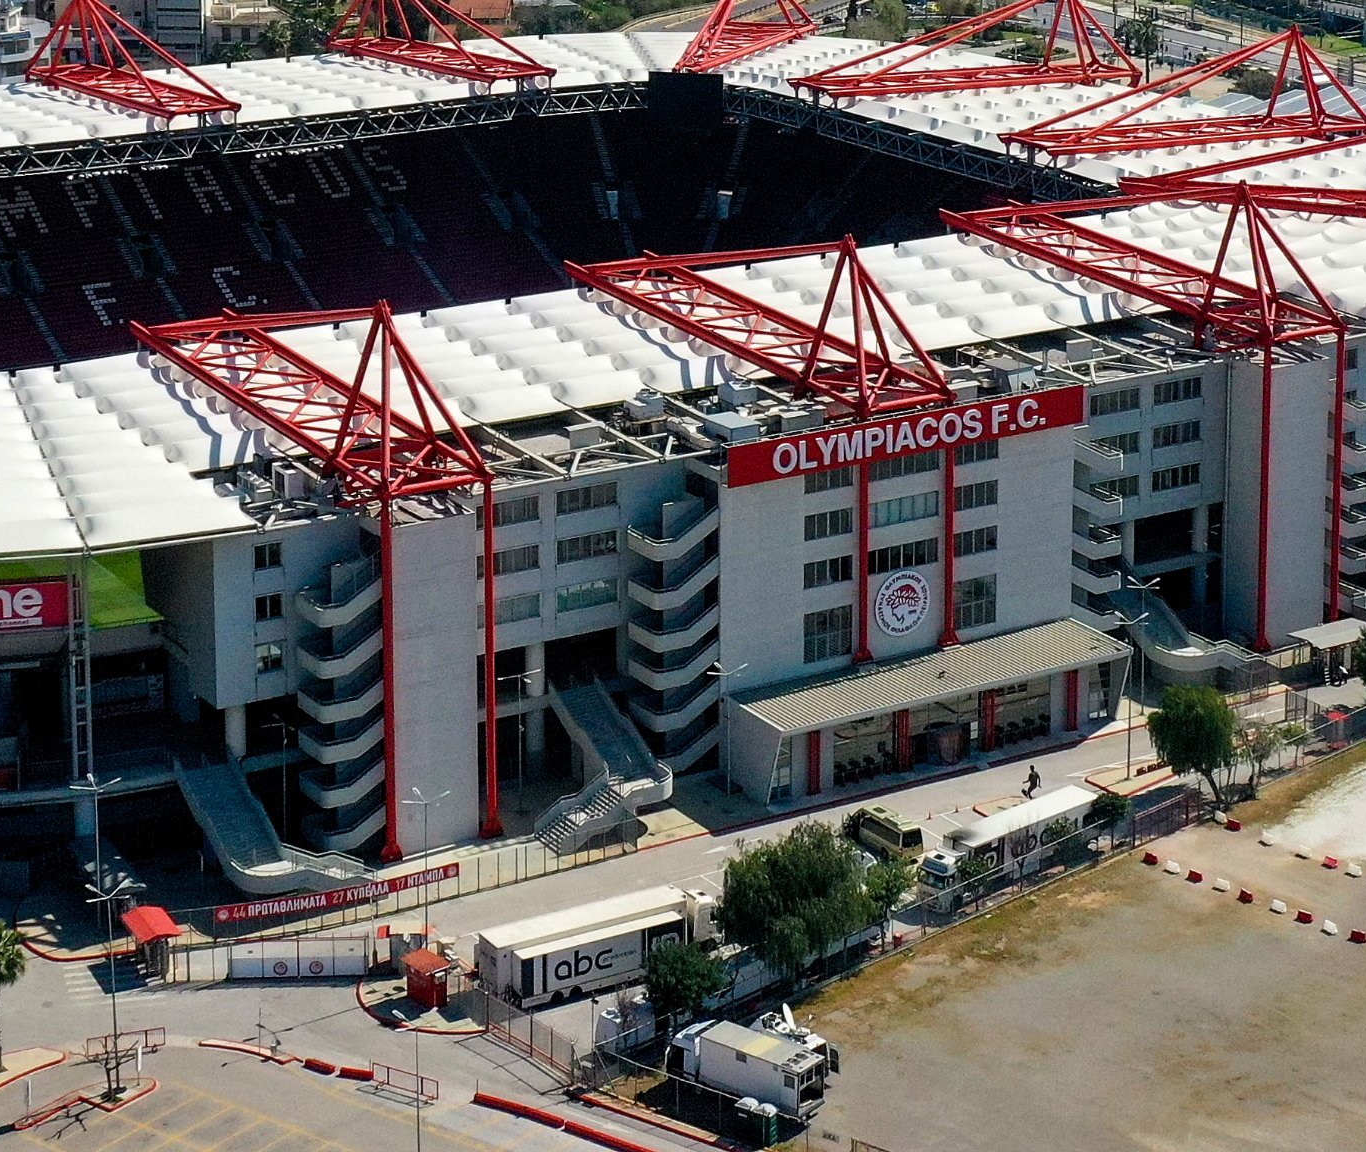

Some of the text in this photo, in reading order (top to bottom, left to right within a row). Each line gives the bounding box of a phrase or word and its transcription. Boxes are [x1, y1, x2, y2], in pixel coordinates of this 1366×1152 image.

[773, 399, 1046, 474] OLYMPIACOS F.C.
[232, 907, 246, 918] 44
[248, 894, 326, 916] ΠΡΩΤΑΘΛΗΜΑΤΑ
[332, 892, 345, 903] 27
[554, 949, 613, 981] abc
